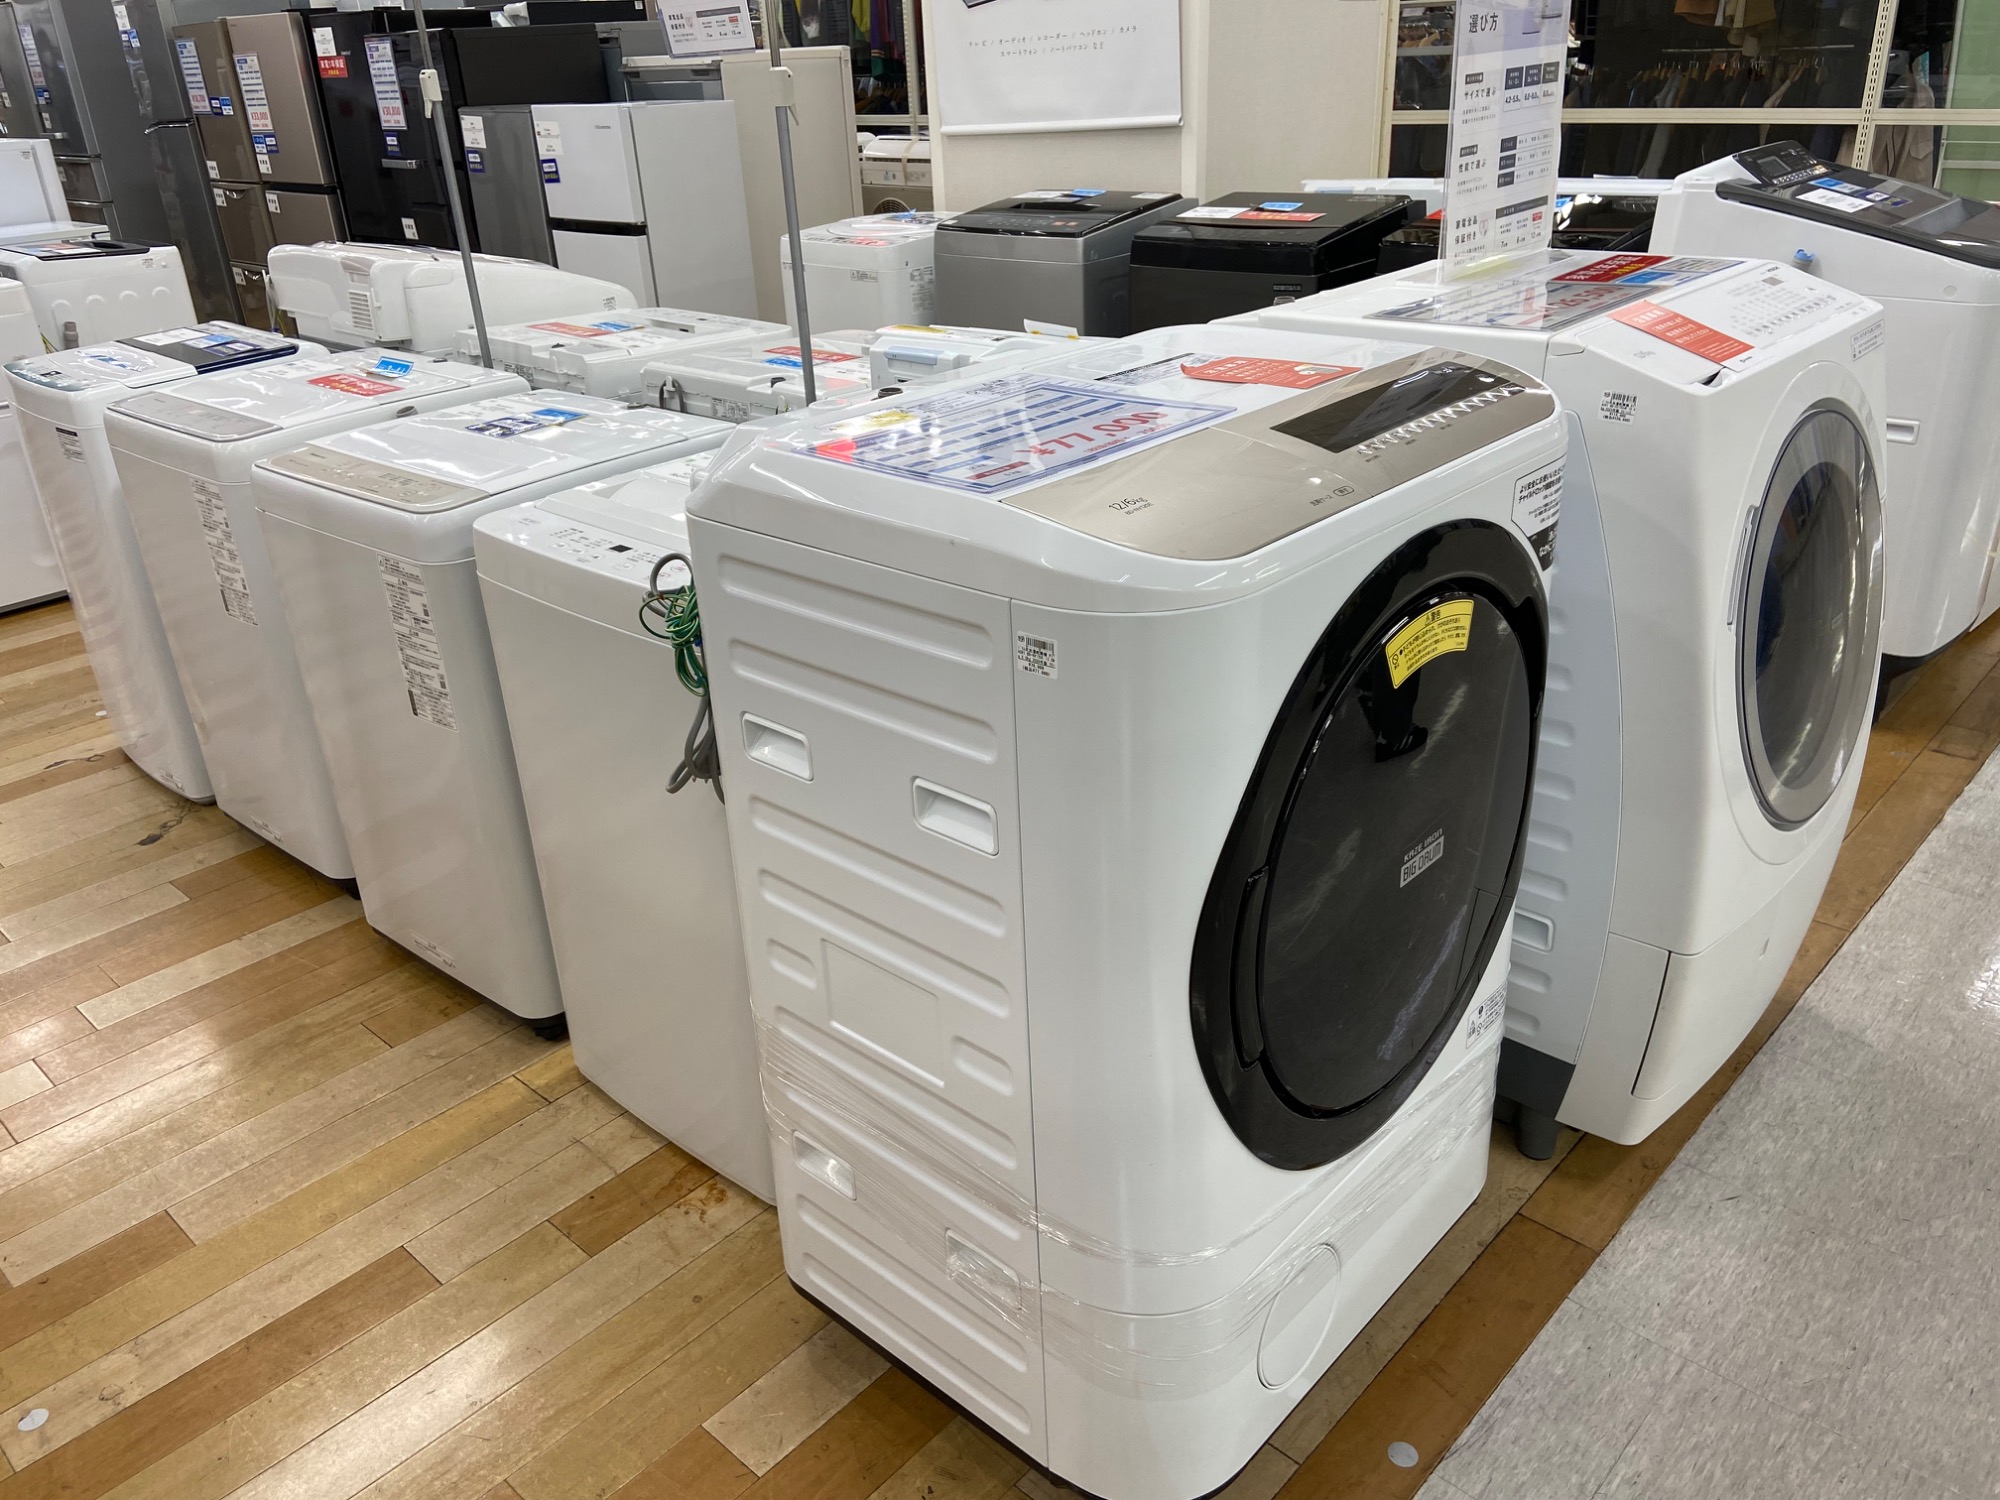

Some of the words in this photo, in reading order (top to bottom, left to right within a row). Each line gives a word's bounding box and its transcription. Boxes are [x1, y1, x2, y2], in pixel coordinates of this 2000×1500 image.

[1468, 12, 1499, 34] 選び方
[999, 36, 1026, 45] オーディオ
[1037, 32, 1068, 41] レコーダー
[1079, 28, 1107, 37] ヘッドホン
[1119, 25, 1137, 34] カメラ
[1000, 47, 1038, 57] スマートフォン
[1049, 43, 1088, 53] ノートパソコン
[1092, 41, 1104, 50] など
[1464, 87, 1497, 100] サイズで選ぶ
[1455, 215, 1478, 230] 家電全品
[1454, 230, 1477, 245] 保証付き
[1014, 411, 1169, 456] ¥77,000
[1402, 857, 1417, 883] BIG
[1418, 841, 1442, 874] DRUM
